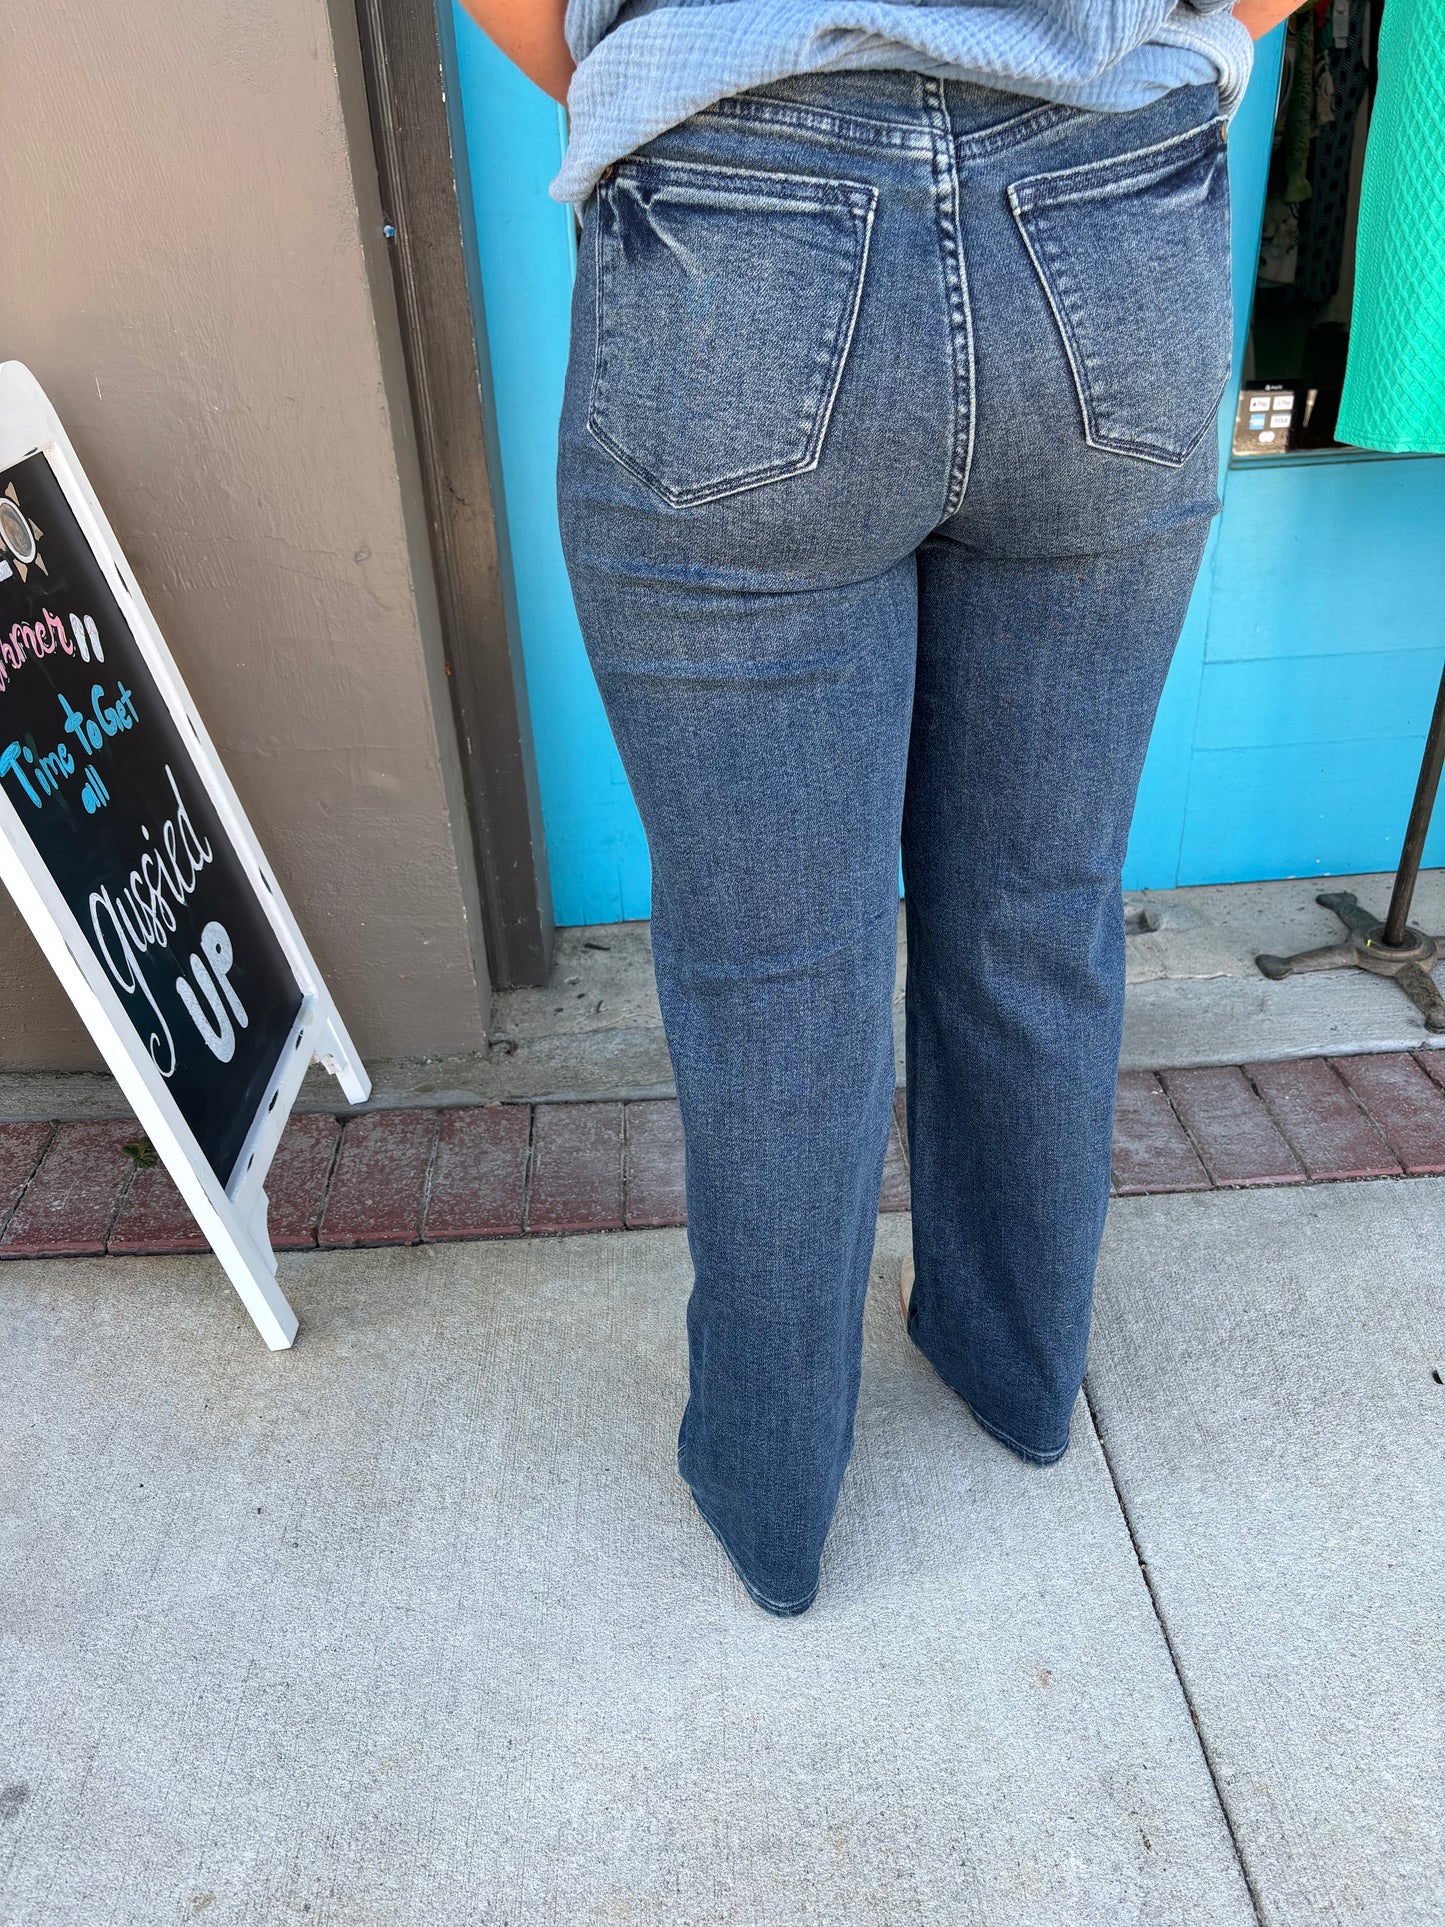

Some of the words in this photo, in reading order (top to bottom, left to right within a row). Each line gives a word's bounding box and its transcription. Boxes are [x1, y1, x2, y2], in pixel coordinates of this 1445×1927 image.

[0, 608, 73, 692] mmer
[0, 740, 75, 809] Time
[58, 693, 103, 756] to
[91, 680, 140, 737] Get
[81, 764, 111, 814] all
[176, 921, 249, 1063] UP
